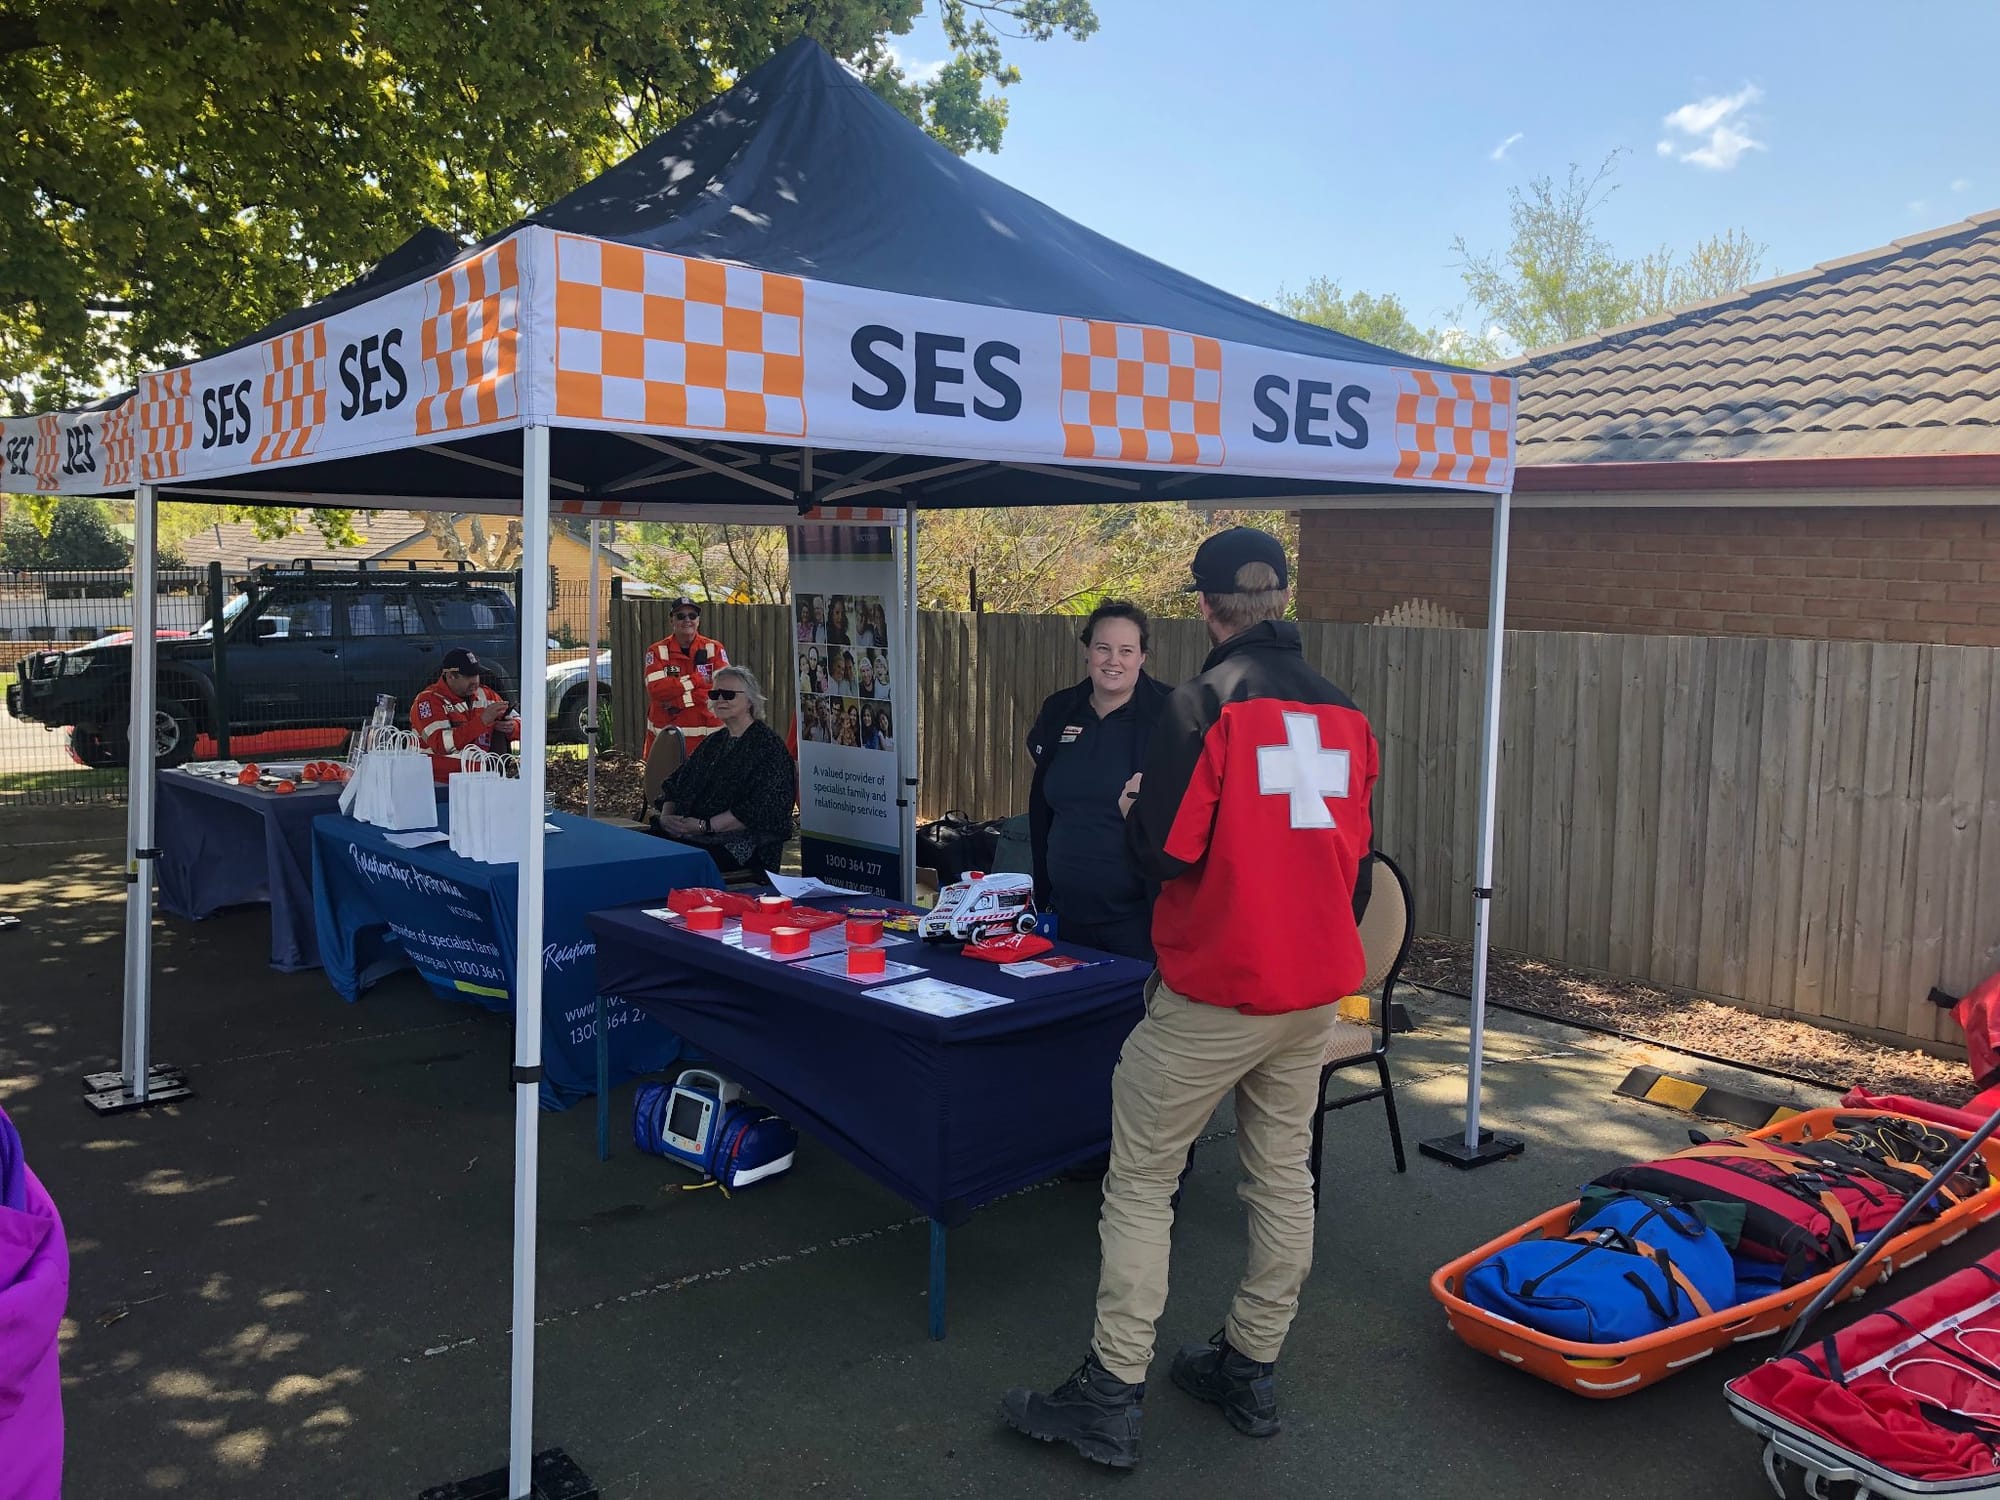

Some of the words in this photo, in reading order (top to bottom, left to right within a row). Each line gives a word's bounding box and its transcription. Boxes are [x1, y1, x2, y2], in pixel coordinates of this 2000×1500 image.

[339, 328, 408, 421] SES
[849, 324, 1022, 421] SES
[202, 379, 252, 449] SES
[1251, 374, 1371, 450] SES
[6, 435, 34, 476] SES
[62, 423, 96, 475] SES
[813, 765, 819, 776] A
[820, 767, 843, 780] valued
[845, 772, 876, 784] provider
[877, 775, 885, 786] of
[813, 783, 846, 796] specialist
[847, 785, 870, 802] family
[872, 790, 887, 802] and
[815, 797, 856, 815] relationship
[857, 806, 887, 818] services
[825, 854, 847, 869] 1300
[848, 859, 864, 873] 364
[866, 862, 882, 876] 277
[418, 929, 429, 944] of
[429, 934, 473, 951] specialist
[454, 961, 480, 977] 1300
[480, 965, 499, 980] 364
